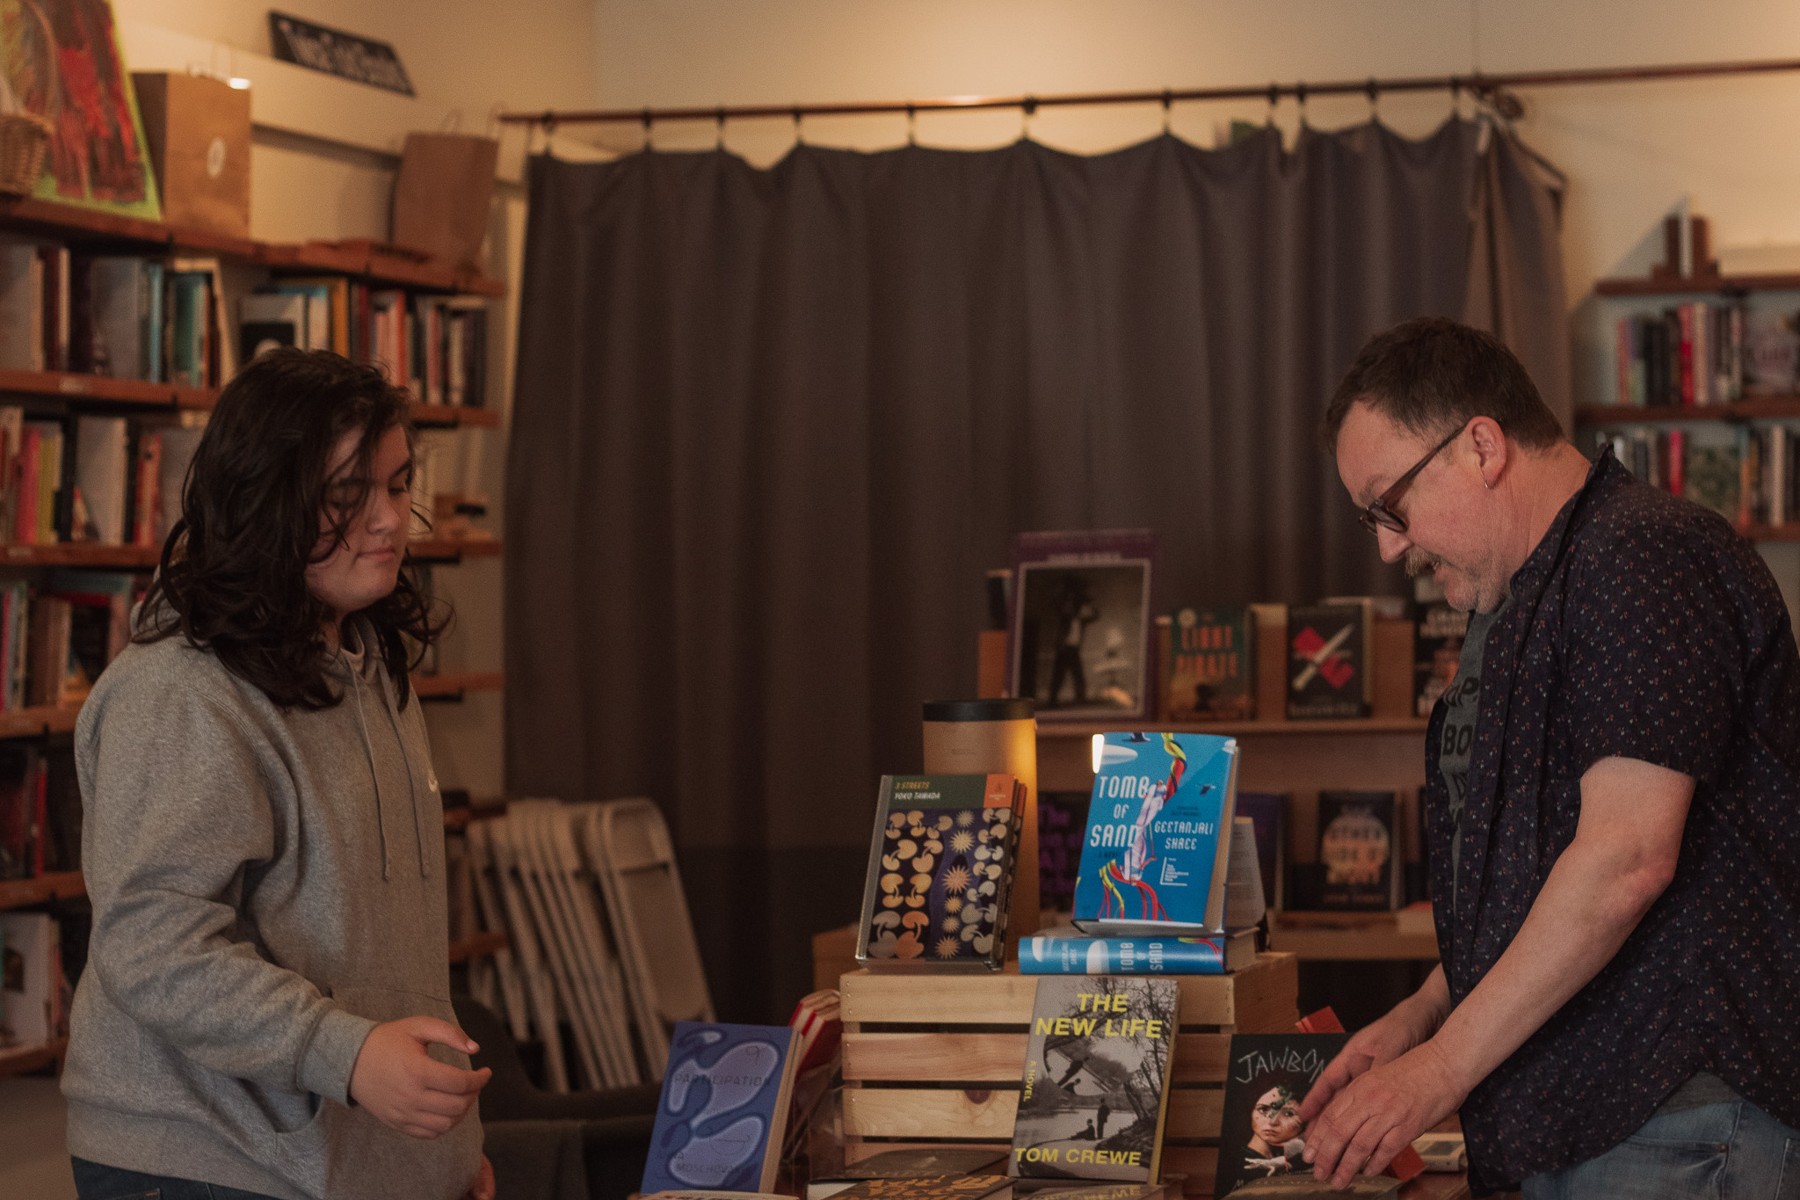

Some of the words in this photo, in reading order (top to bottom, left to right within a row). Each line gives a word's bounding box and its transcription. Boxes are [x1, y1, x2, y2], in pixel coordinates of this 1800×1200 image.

[901, 781, 930, 790] STREETS
[1098, 775, 1150, 799] TOMB
[894, 792, 913, 801] YOKO
[1113, 803, 1130, 819] OF
[1090, 823, 1139, 848] SAND
[1153, 820, 1214, 835] GEETANJALI
[1164, 837, 1198, 850] SHREE
[1120, 941, 1135, 971] TOMB
[1148, 941, 1164, 971] SAND
[1076, 993, 1130, 1013] THE
[1034, 1017, 1098, 1037] NEW
[1104, 1018, 1163, 1039] LIFE
[1234, 1045, 1325, 1084] JAWBO
[1023, 1068, 1036, 1102] NOVEL
[1015, 1147, 1060, 1163] TOM
[1065, 1148, 1143, 1167] CREWE
